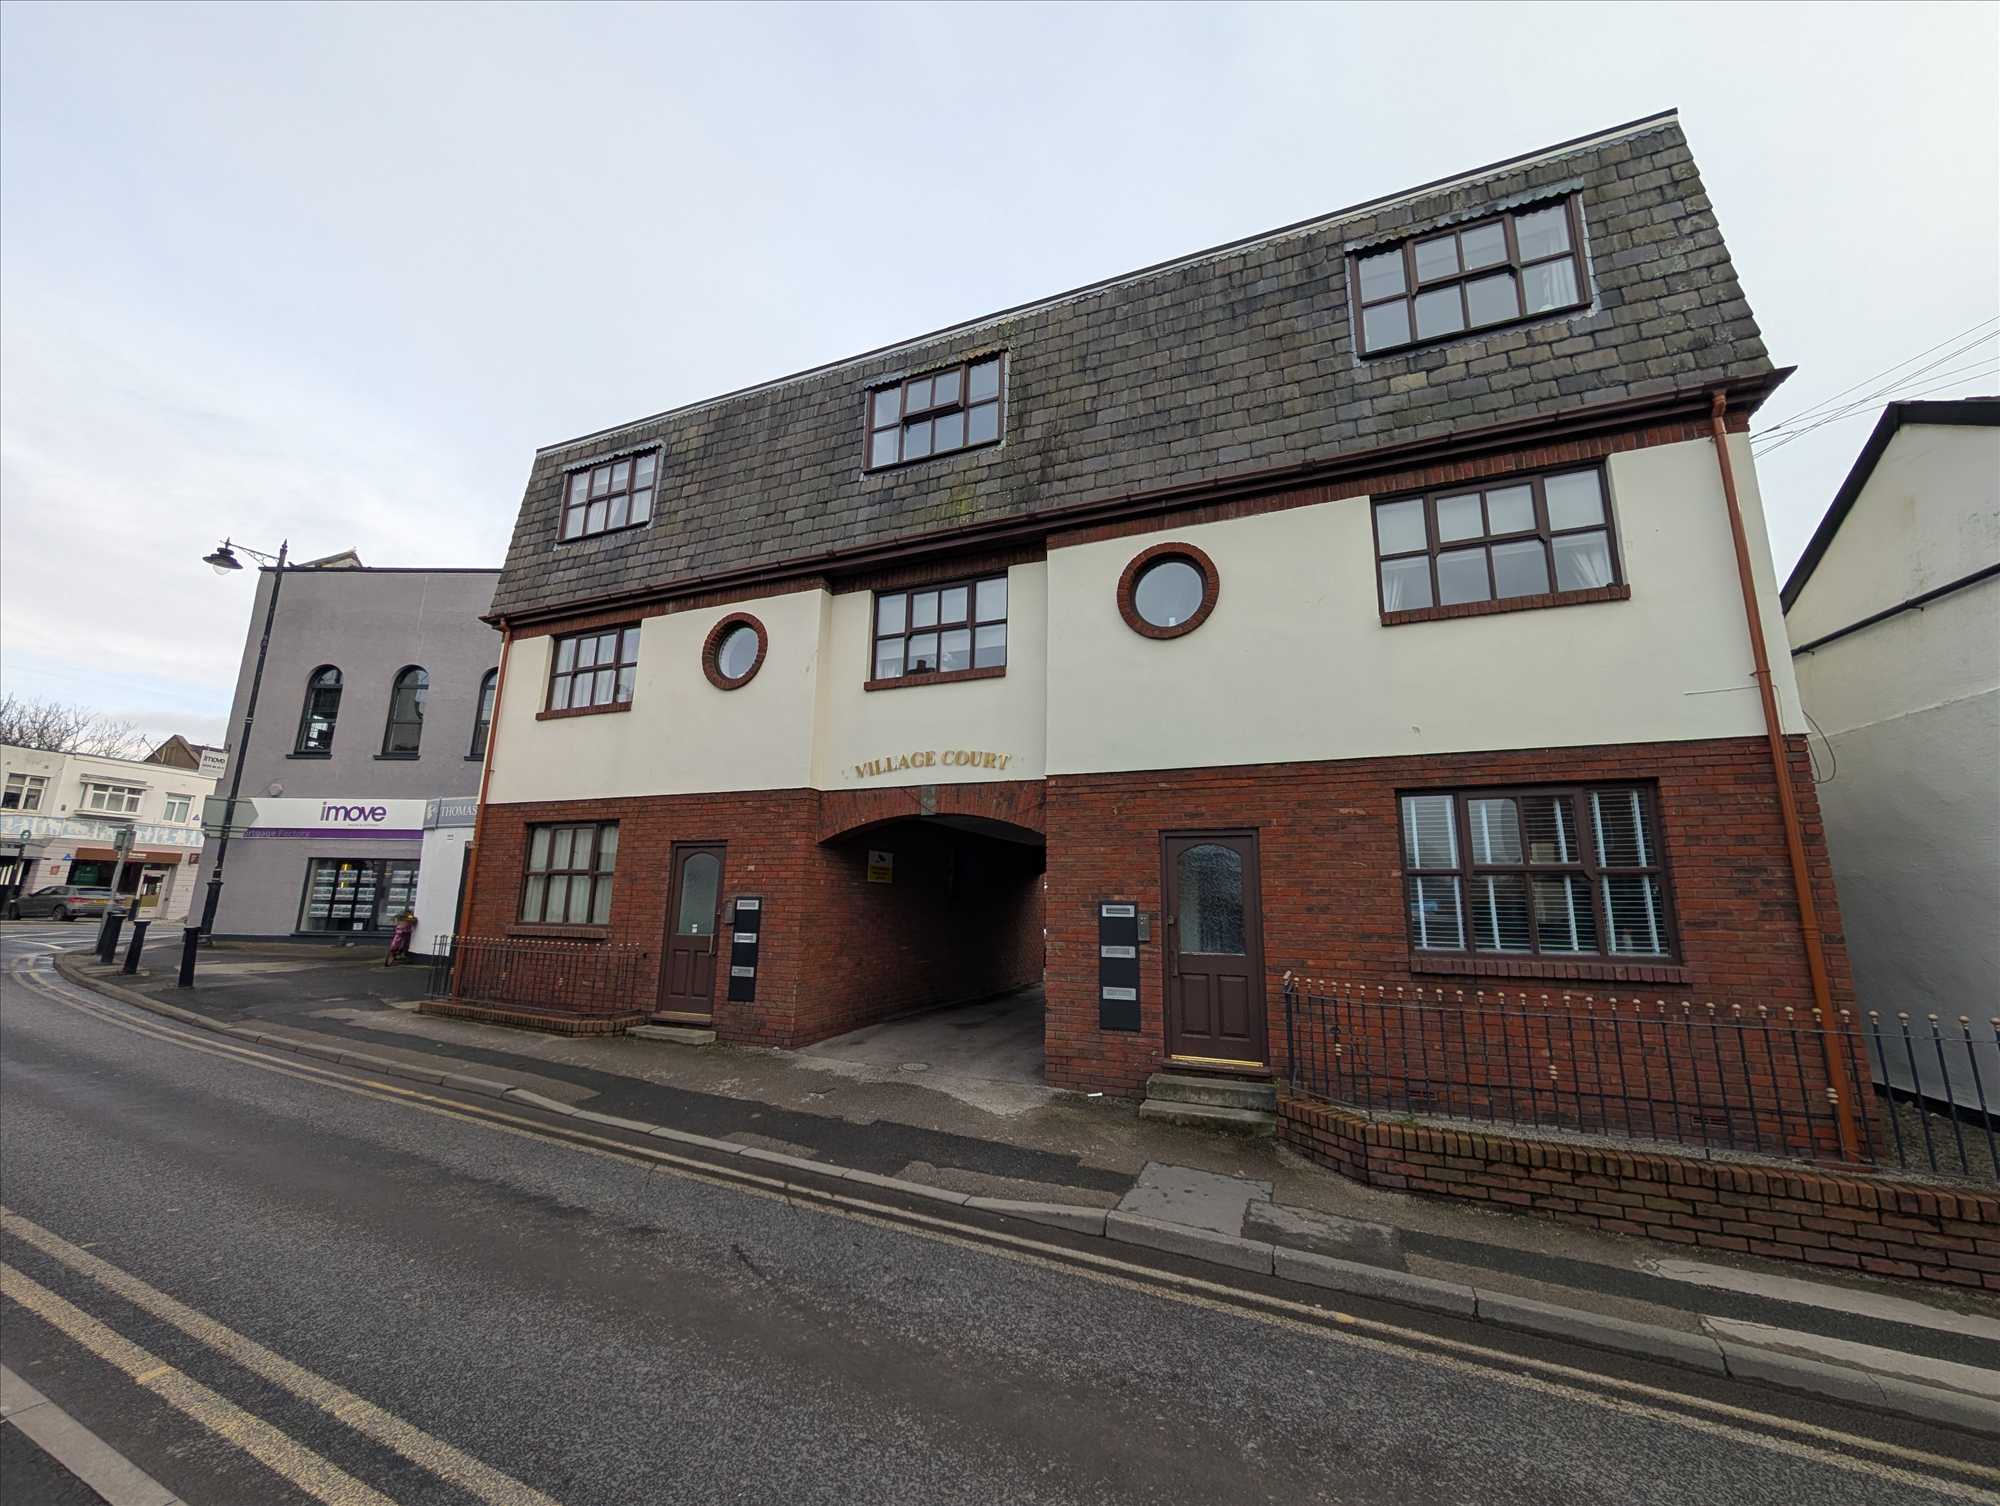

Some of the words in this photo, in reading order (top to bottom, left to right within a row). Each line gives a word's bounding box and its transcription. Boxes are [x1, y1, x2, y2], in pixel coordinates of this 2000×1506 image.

[855, 751, 936, 779] VILLAGE
[941, 750, 1010, 770] COURT
[320, 801, 387, 822] imove
[440, 805, 478, 817] THOMAS
